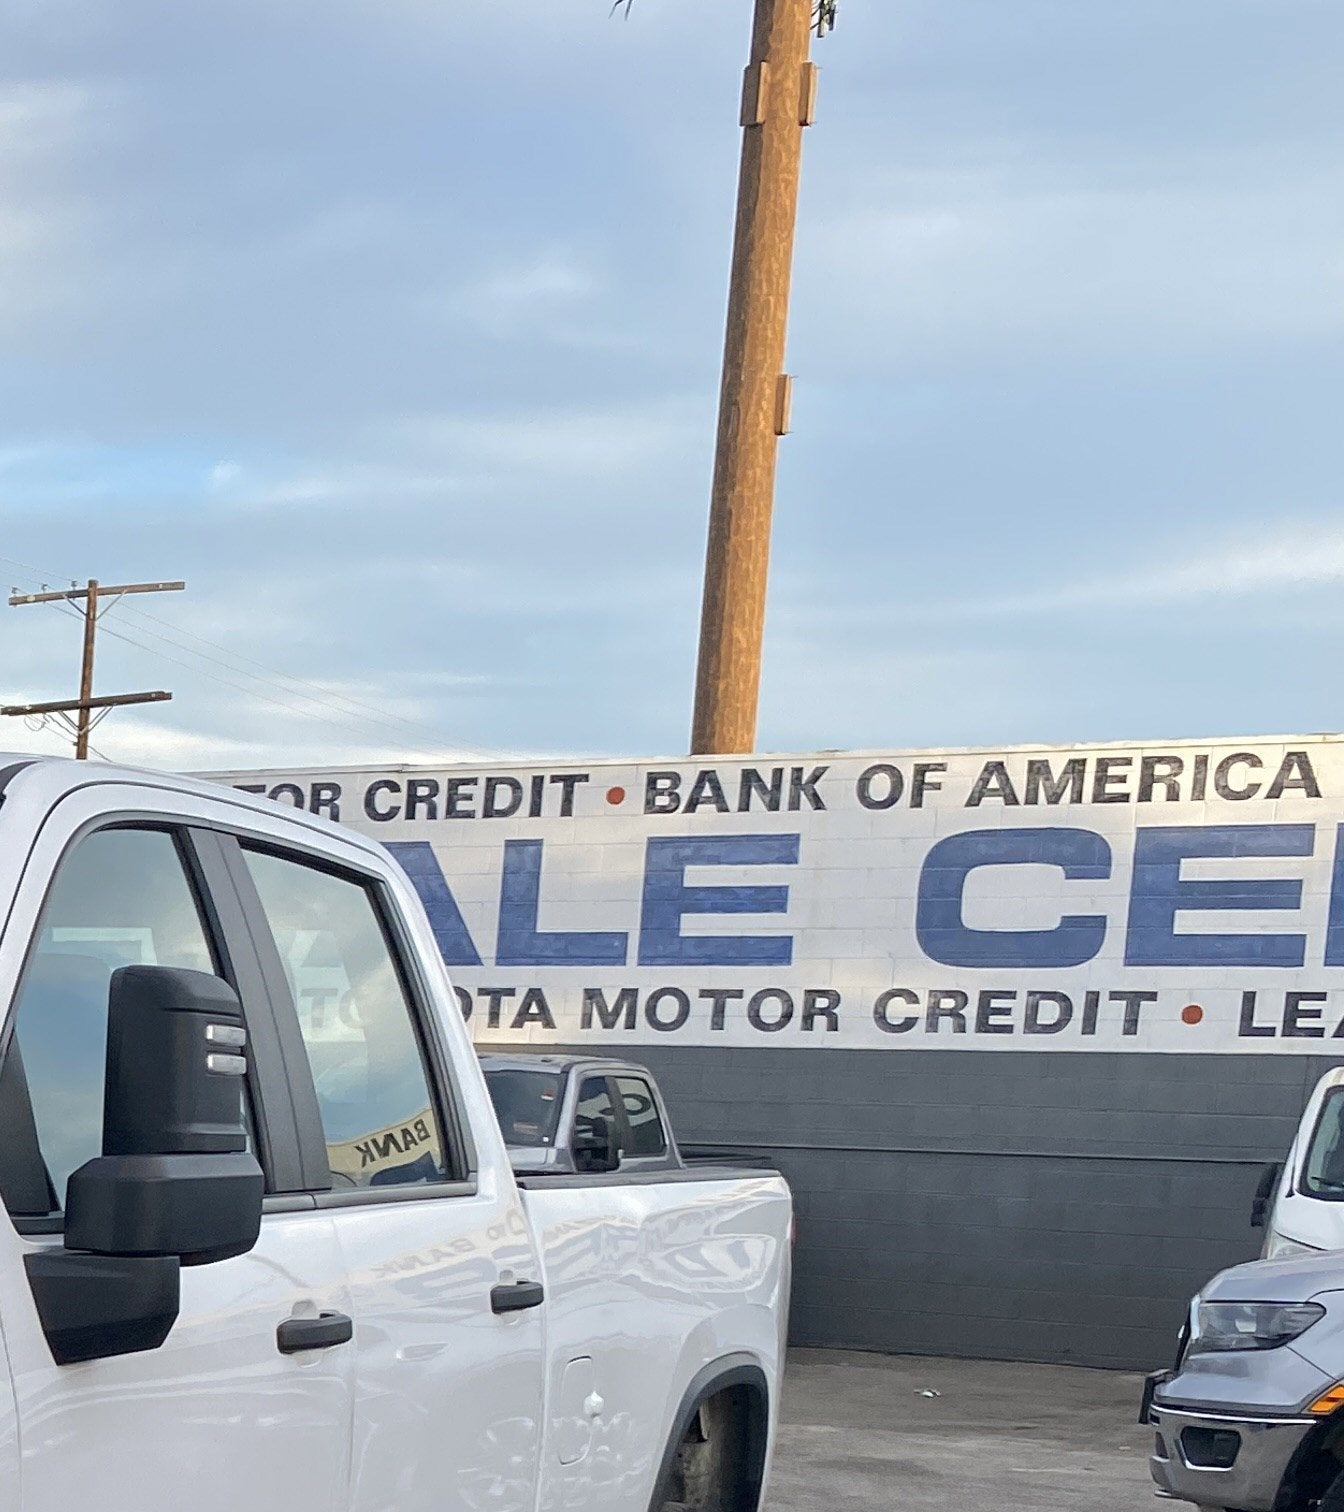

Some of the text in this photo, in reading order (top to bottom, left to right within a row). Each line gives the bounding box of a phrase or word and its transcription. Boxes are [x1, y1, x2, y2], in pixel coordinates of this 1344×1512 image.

[364, 773, 589, 822] CREDIT
[643, 767, 829, 815] BANK
[856, 761, 948, 811] OF
[964, 750, 1323, 808] AMERICA
[915, 823, 1344, 968] CE
[580, 986, 842, 1032] MOTOR
[873, 989, 1158, 1035] CREDIT
